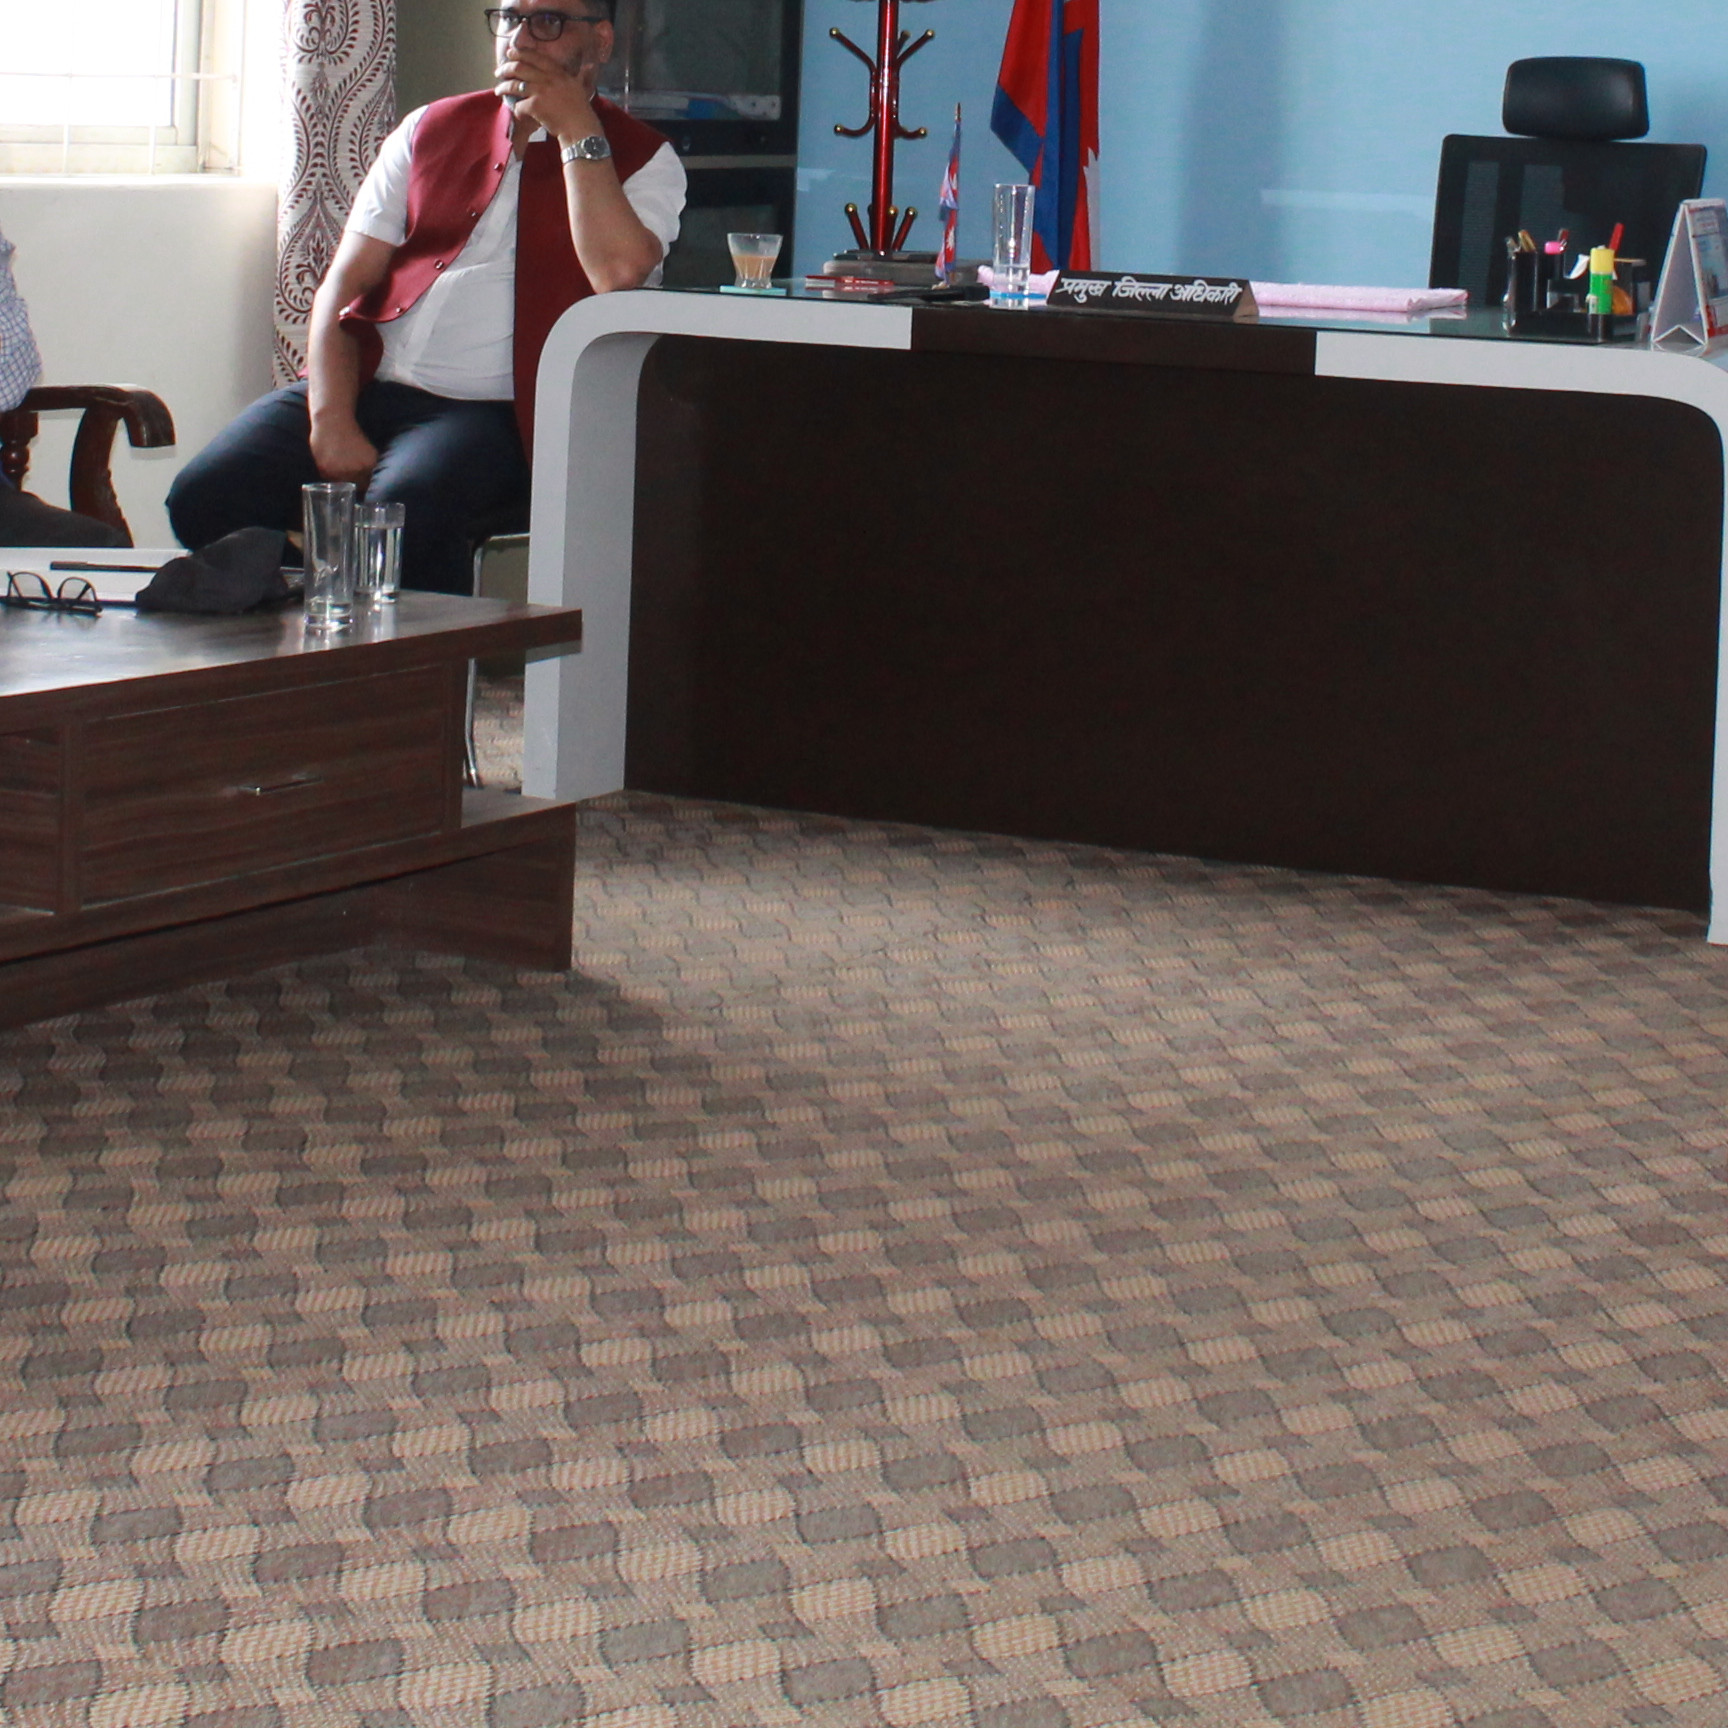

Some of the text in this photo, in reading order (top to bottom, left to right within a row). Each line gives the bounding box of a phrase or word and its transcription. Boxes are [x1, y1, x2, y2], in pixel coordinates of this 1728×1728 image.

[1055, 275, 1242, 304] प्रमुख जिल्ला अधिकारी
